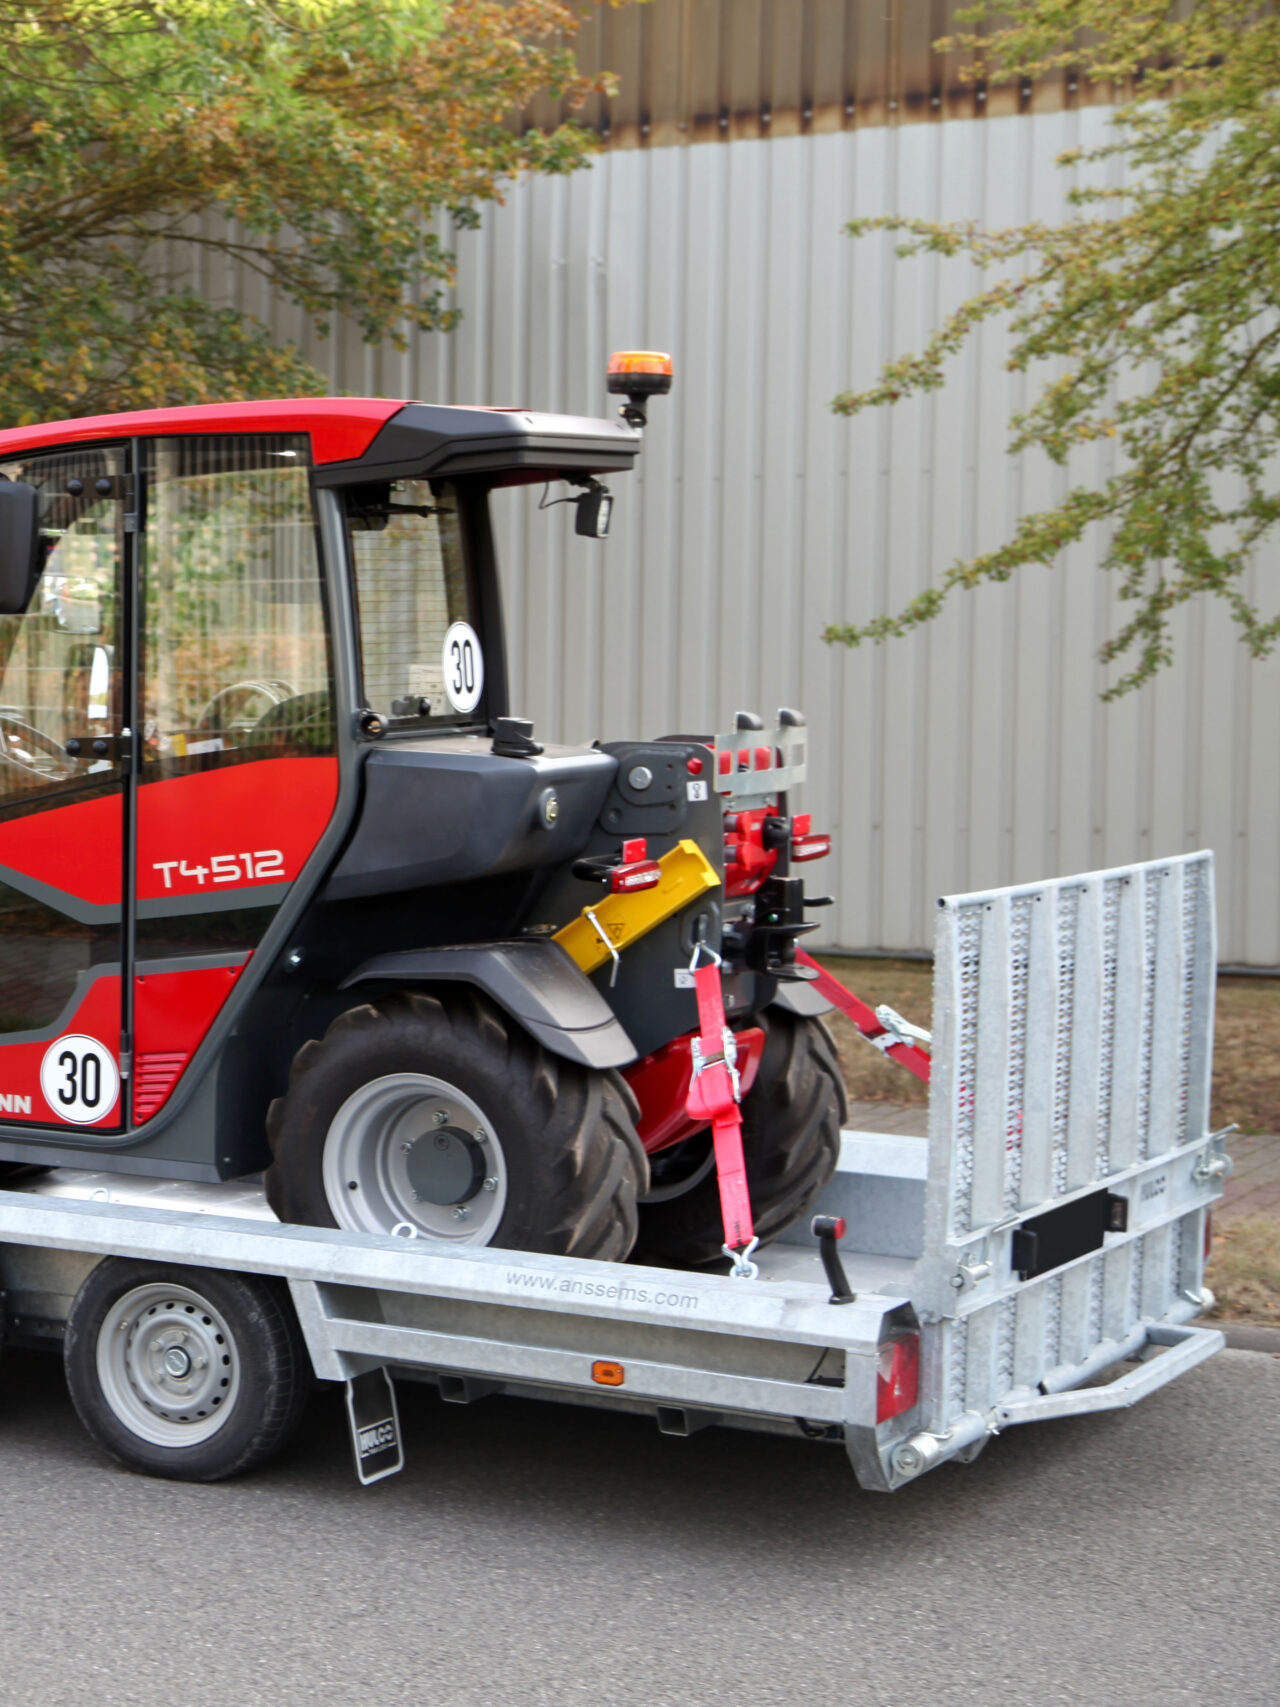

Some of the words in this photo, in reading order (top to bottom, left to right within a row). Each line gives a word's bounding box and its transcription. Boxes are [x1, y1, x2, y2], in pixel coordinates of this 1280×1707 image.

[451, 639, 475, 695] 30
[153, 850, 285, 888] T4512
[58, 1050, 101, 1108] 30
[506, 1271, 699, 1309] www.anssems.com
